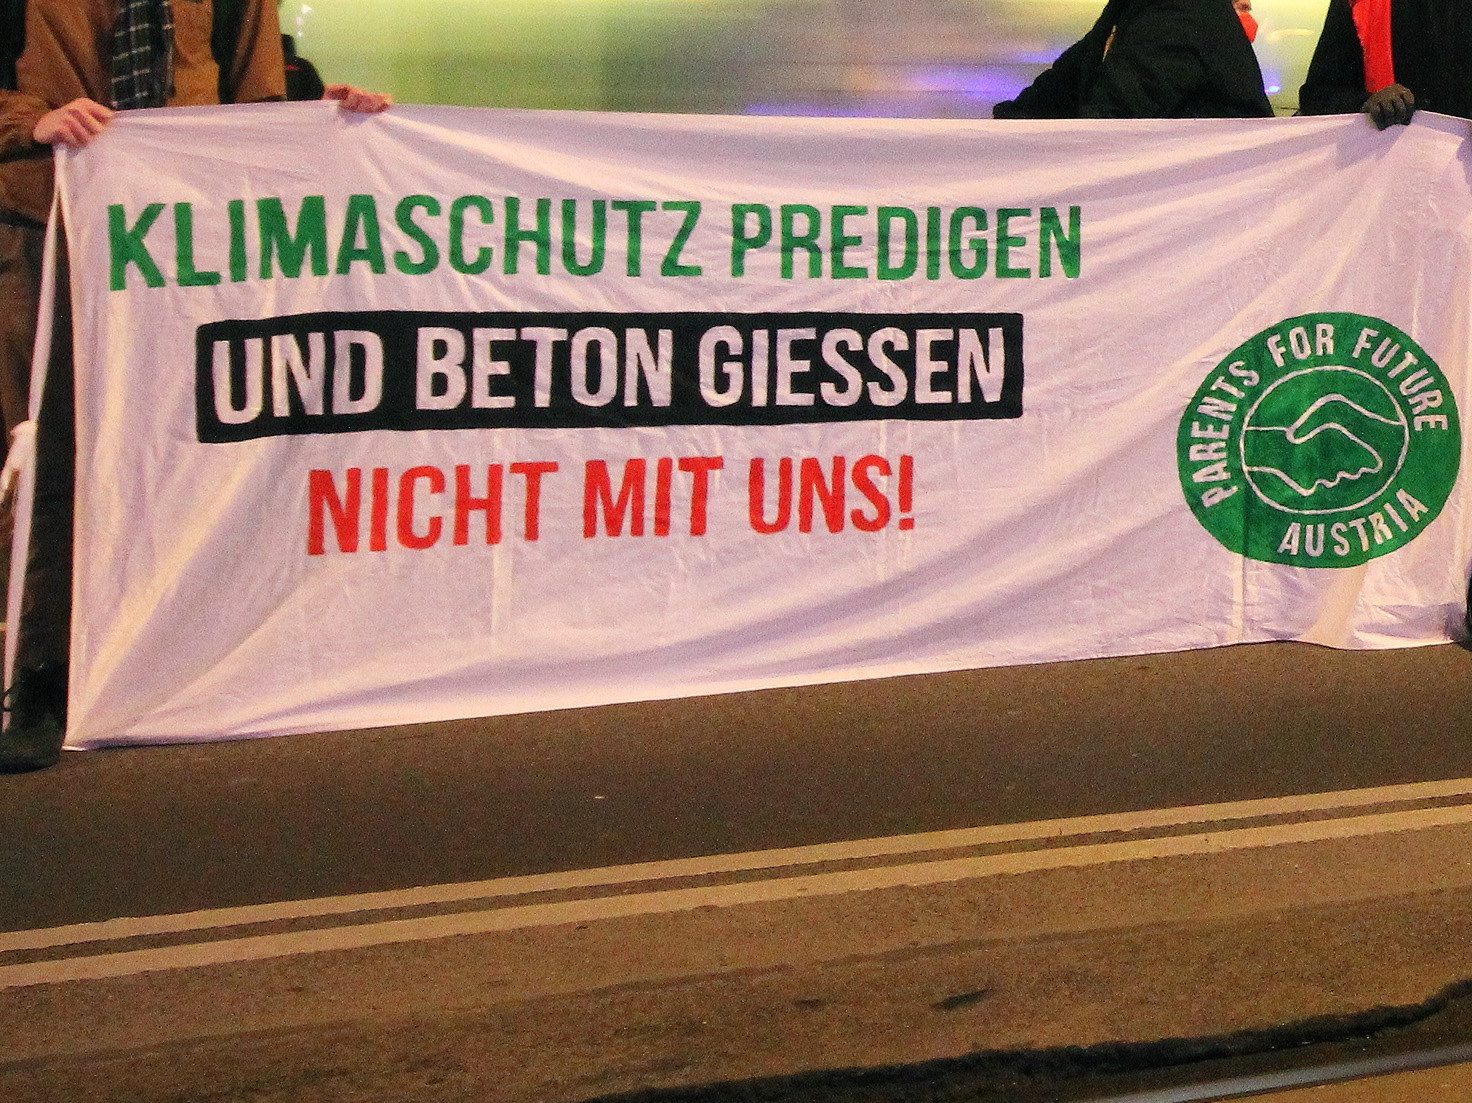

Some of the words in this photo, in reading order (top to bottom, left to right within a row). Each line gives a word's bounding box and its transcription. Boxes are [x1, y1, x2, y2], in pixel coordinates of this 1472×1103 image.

[108, 194, 703, 291] KLIMASCHUTZ
[731, 203, 1082, 281] PREDIGEN
[212, 329, 385, 426] UND
[415, 325, 674, 411] BETON
[699, 324, 1004, 408] GIESSEN
[1189, 360, 1260, 508] PARENTS
[1267, 322, 1335, 368] FOR
[1352, 327, 1449, 431] FUTURE
[307, 460, 560, 556] NICHT
[582, 455, 724, 539] MIT
[748, 453, 915, 537] UNS!
[1277, 488, 1430, 558] AUSTRIA
